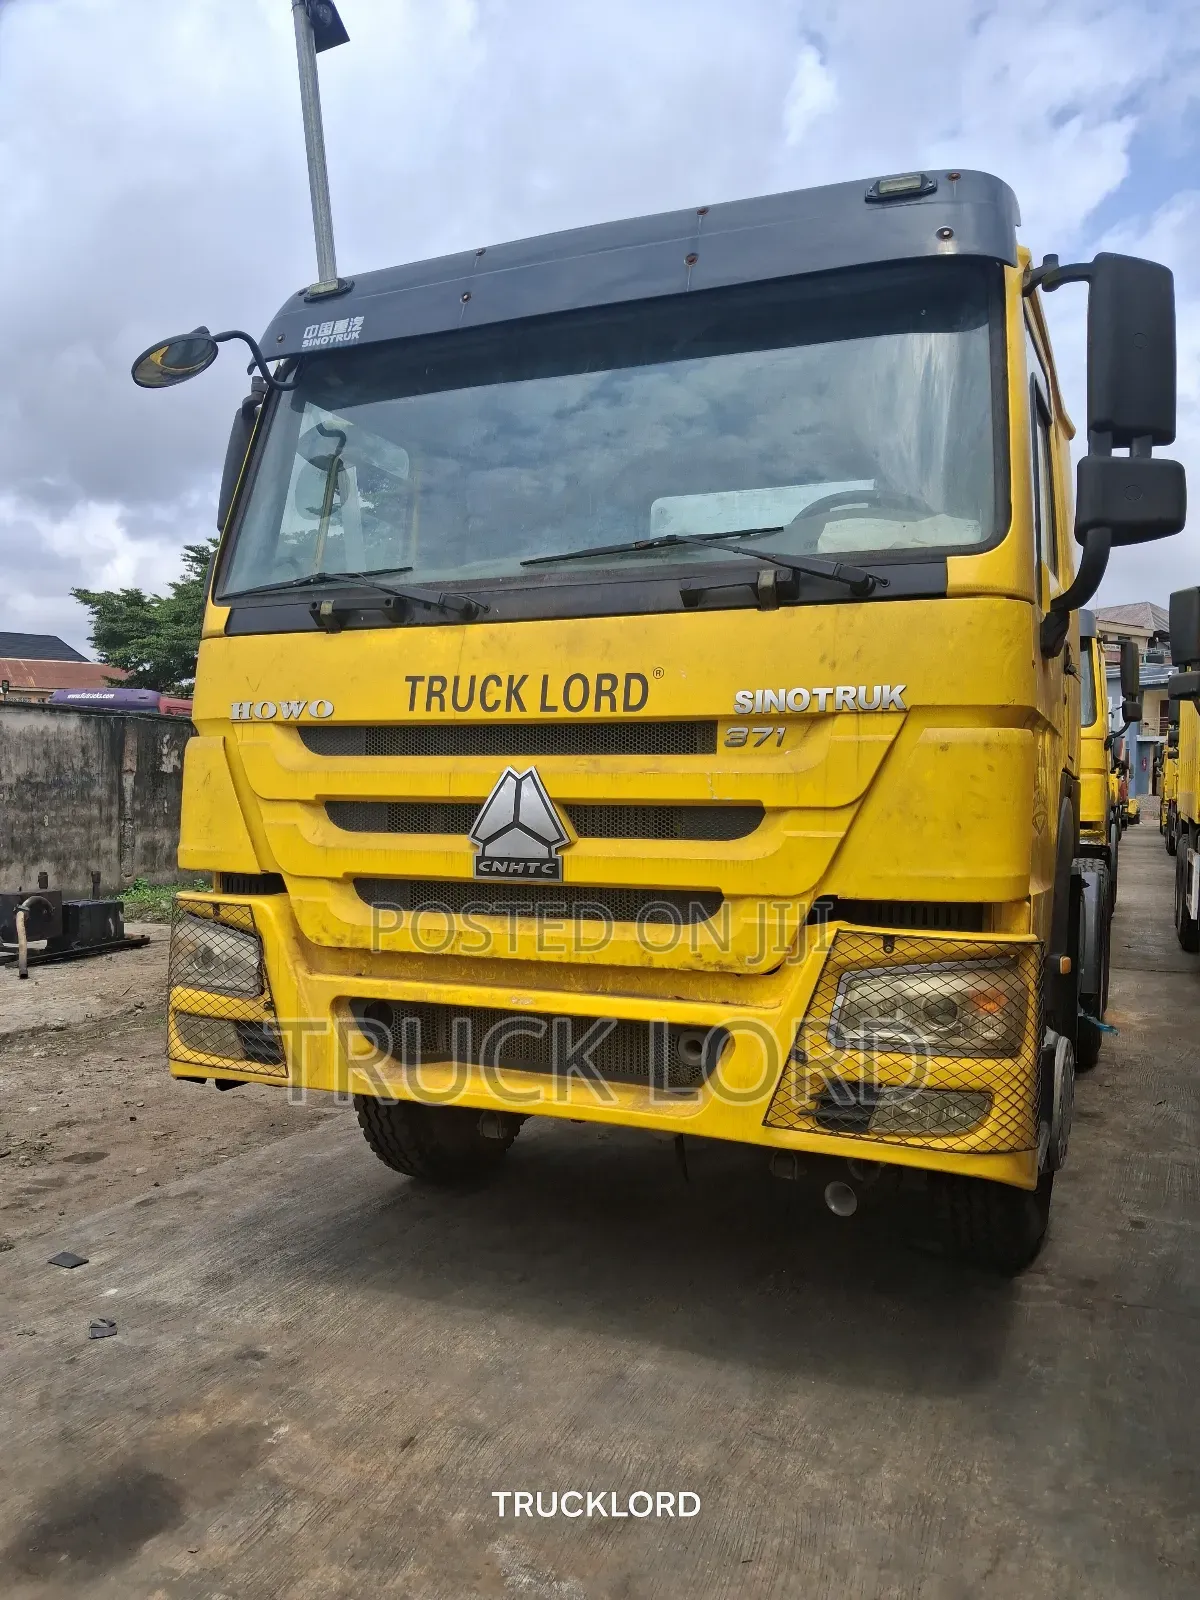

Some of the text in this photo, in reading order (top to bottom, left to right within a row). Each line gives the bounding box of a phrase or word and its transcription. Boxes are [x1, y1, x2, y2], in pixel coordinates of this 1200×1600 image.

[303, 316, 365, 339] 中国重汽
[301, 331, 361, 348] SINOTRUK
[404, 674, 529, 713] TRUCK
[733, 684, 907, 715] SINOTRUK
[229, 699, 335, 721] HOWO
[724, 727, 787, 748] 371
[477, 859, 557, 876] CNHTC
